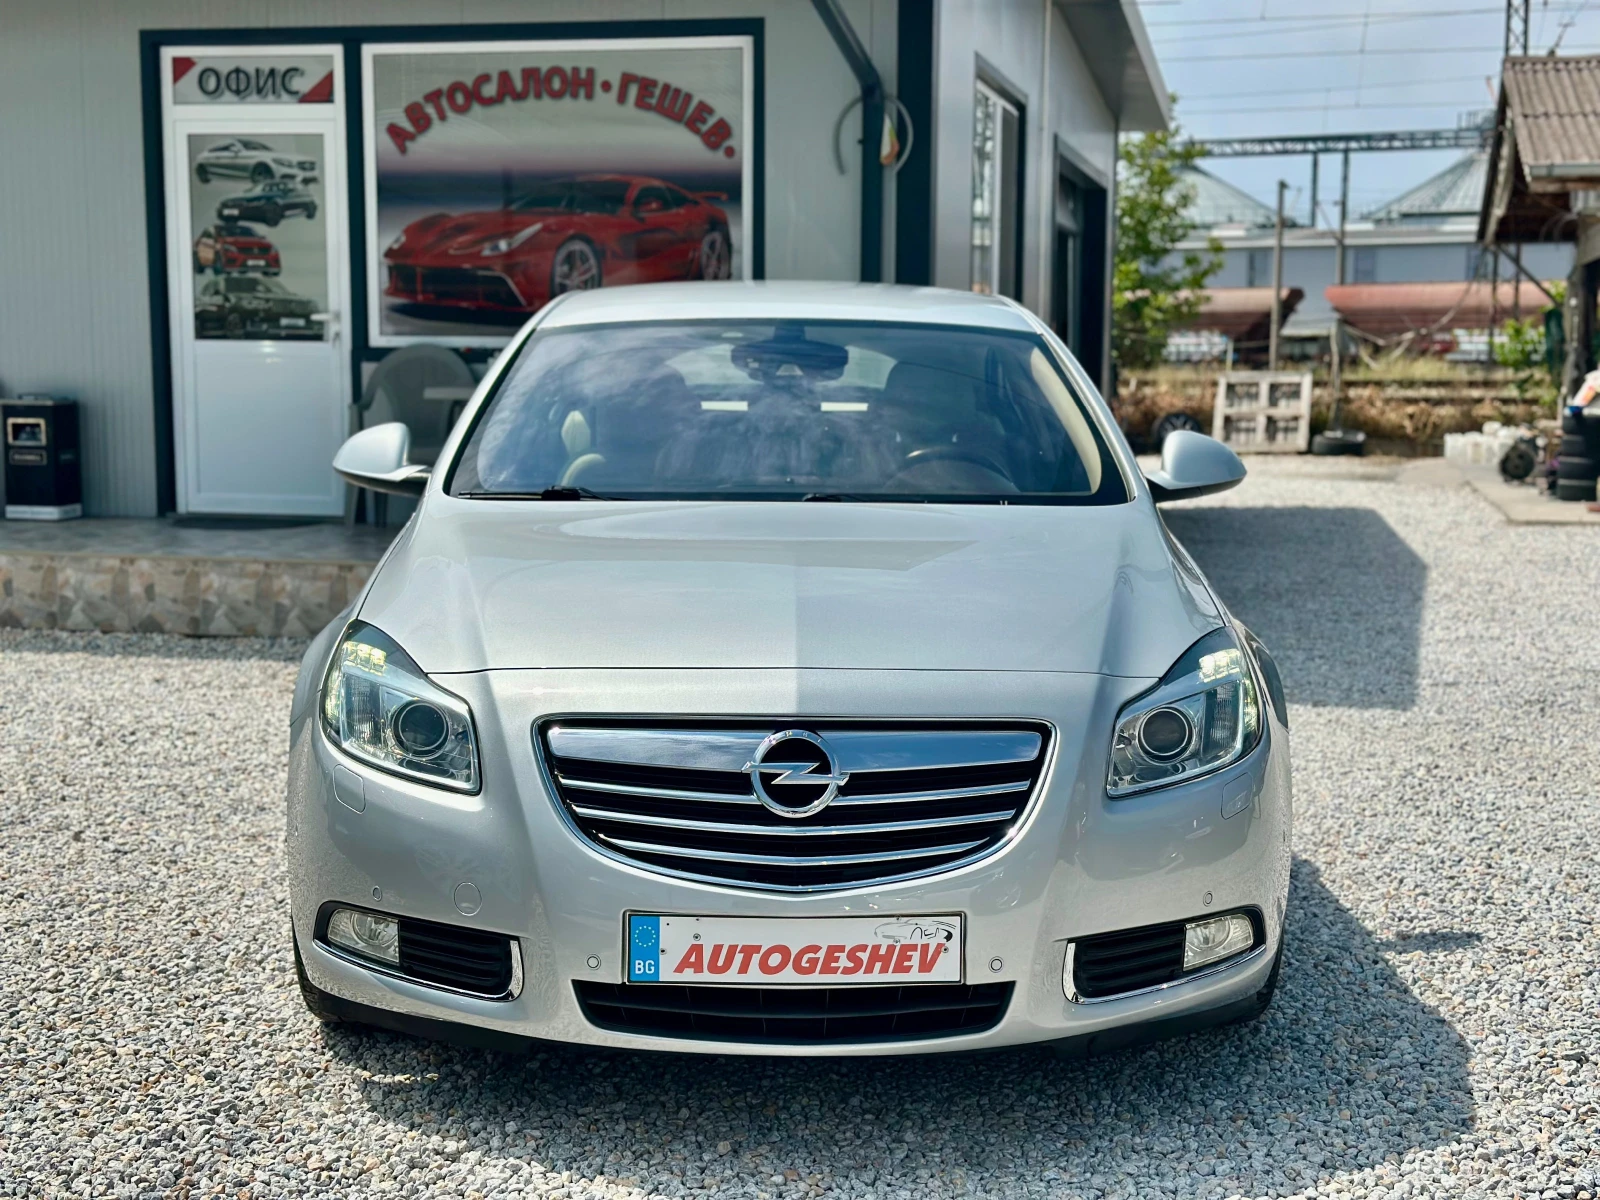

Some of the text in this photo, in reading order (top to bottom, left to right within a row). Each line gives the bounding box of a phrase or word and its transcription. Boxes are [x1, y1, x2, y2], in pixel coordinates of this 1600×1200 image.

[197, 66, 305, 98] ОФИС
[385, 65, 596, 157] АВТОСАЛОН
[634, 959, 656, 975] BG
[673, 942, 946, 976] AUTOGESHEV
